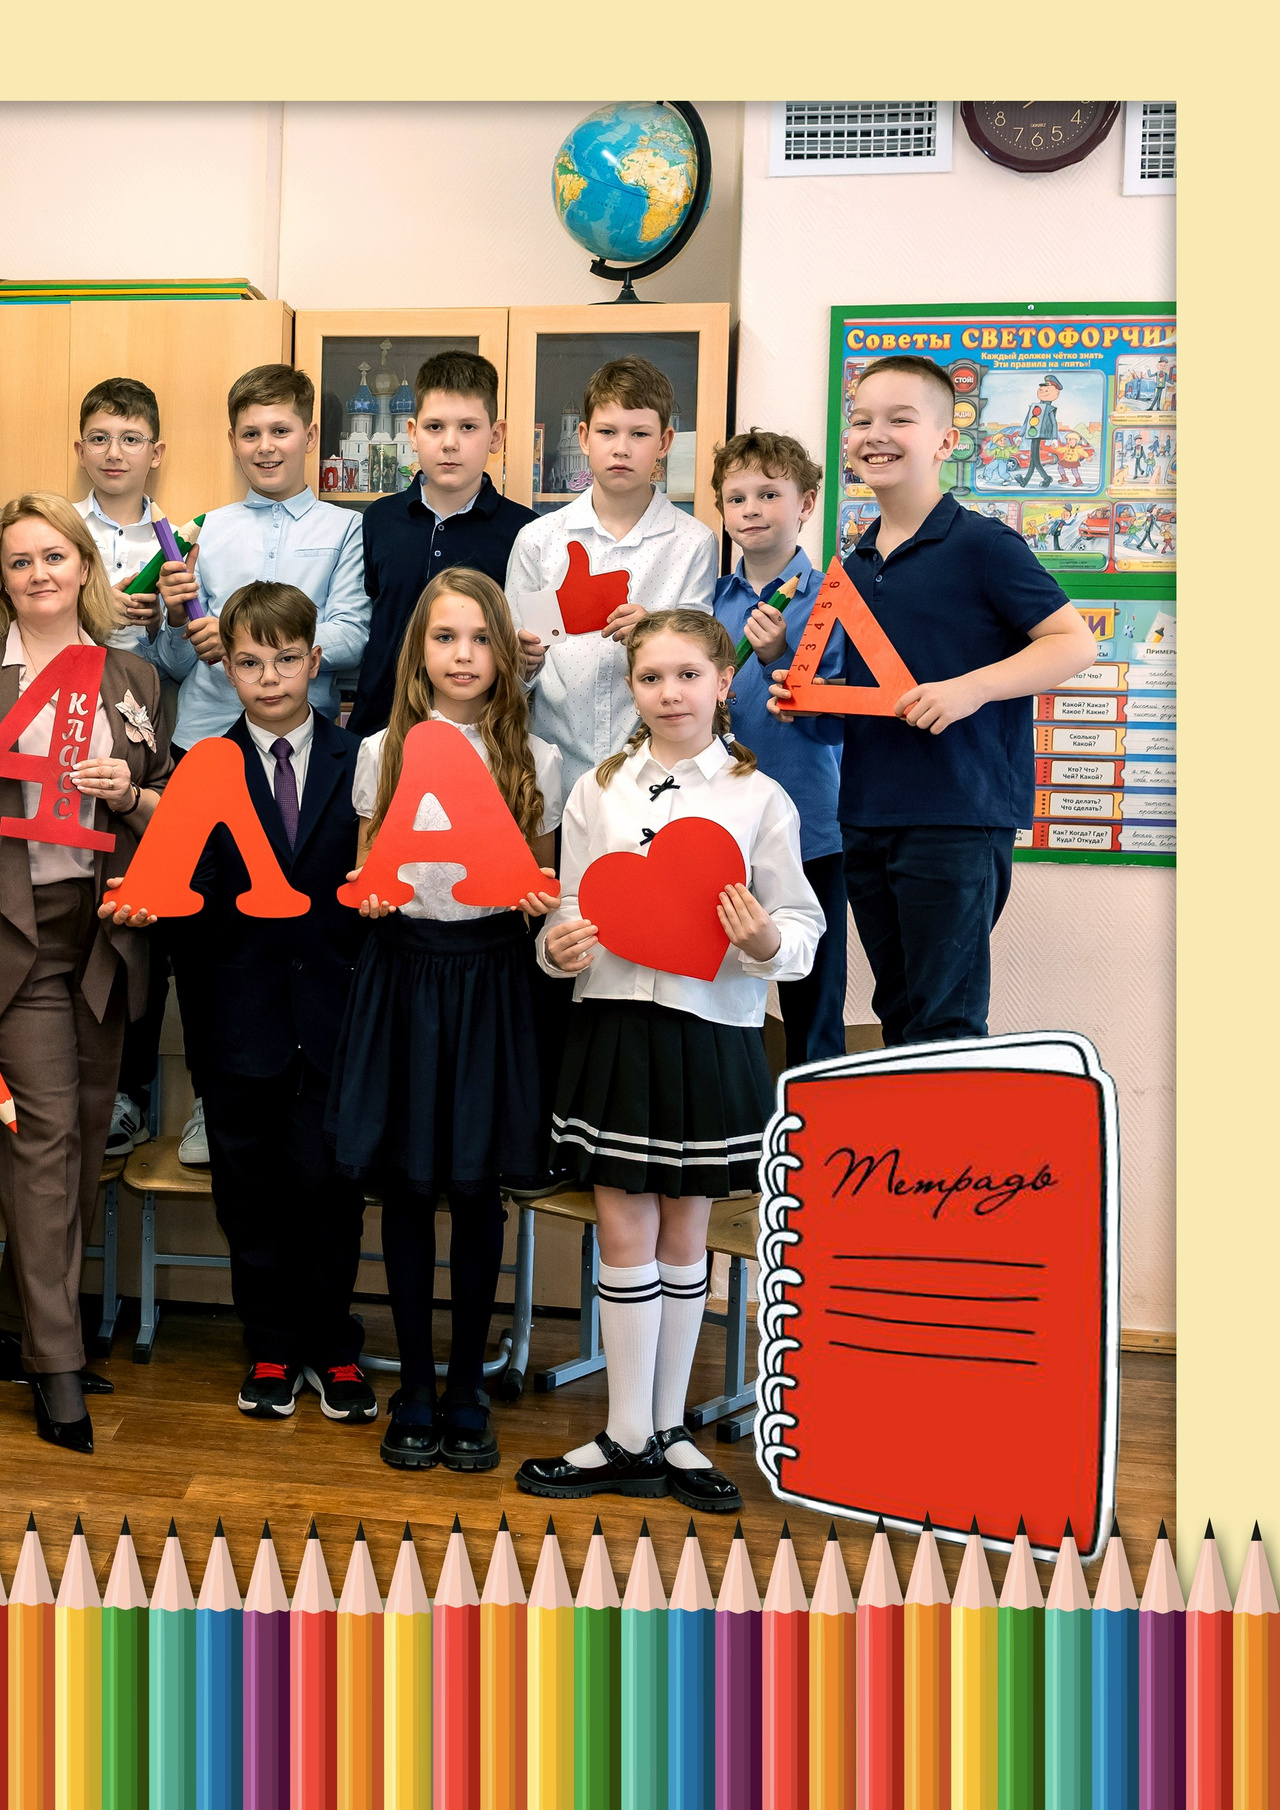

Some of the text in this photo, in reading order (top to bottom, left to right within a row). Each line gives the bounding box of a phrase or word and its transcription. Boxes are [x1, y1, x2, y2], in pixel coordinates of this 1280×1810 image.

[994, 110, 1006, 127] 8
[1070, 109, 1082, 125] 4
[1013, 127, 1024, 142] 7
[1031, 132, 1044, 147] 6
[1050, 126, 1063, 142] 5
[846, 328, 951, 350] Советы
[981, 352, 1017, 361] Каждый
[1018, 353, 1051, 361] должен
[1053, 352, 1078, 360] чётко
[1011, 361, 1047, 369] правила
[954, 376, 974, 384] СТОЙ!
[814, 622, 824, 630] 4
[798, 664, 810, 672] 2
[1075, 798, 1102, 806] делать?
